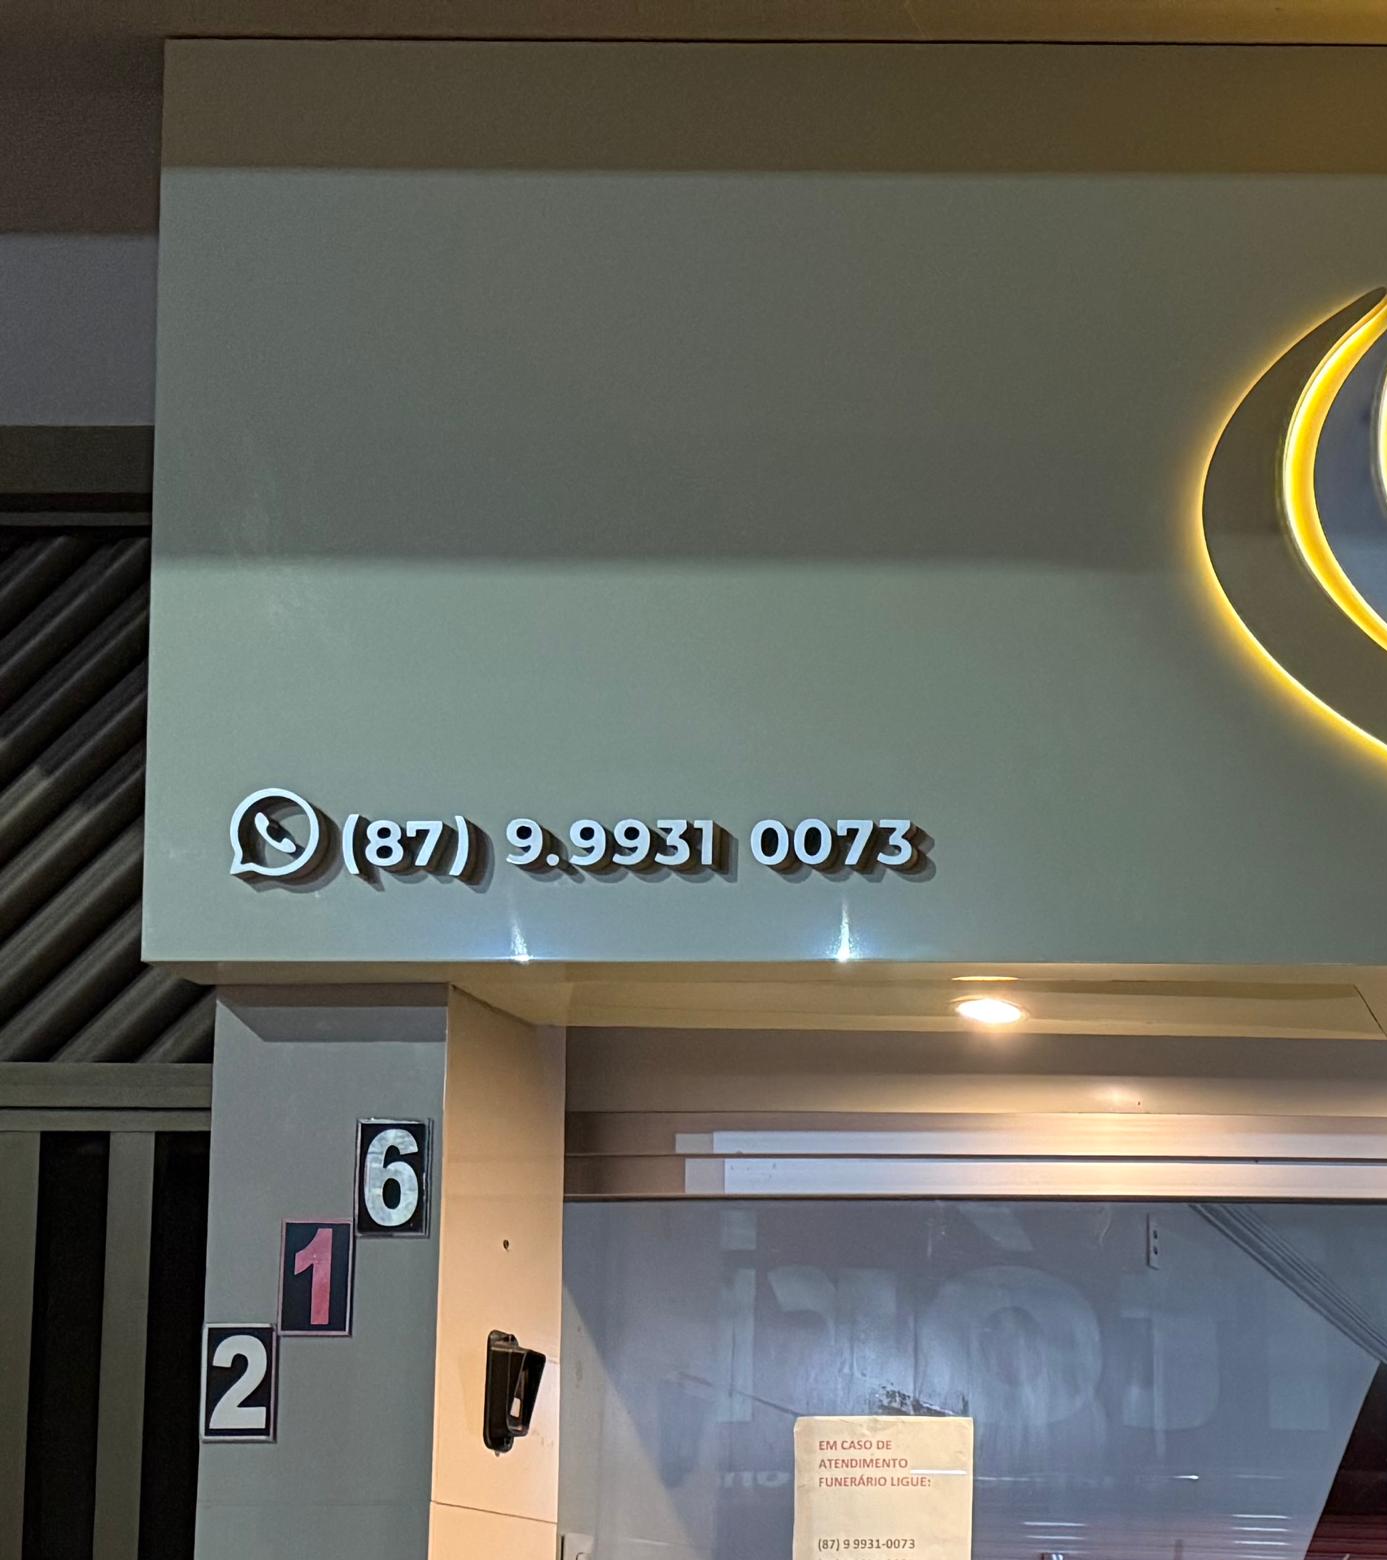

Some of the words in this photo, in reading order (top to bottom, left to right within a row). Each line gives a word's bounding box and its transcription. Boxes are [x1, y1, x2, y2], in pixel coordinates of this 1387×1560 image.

[342, 813, 466, 878] (87)
[505, 817, 715, 868] 9.9931
[750, 817, 913, 868] 0073
[818, 1440, 838, 1451] EM
[841, 1439, 873, 1451] CASO
[876, 1439, 892, 1450] DE
[818, 1458, 908, 1469] ATENDIMENTO
[818, 1474, 887, 1487] FUNERÁRIO
[891, 1476, 932, 1487] LIGUE:
[817, 1538, 840, 1552] (87)
[842, 1539, 850, 1549] 9
[852, 1538, 915, 1549] 9931-0073
